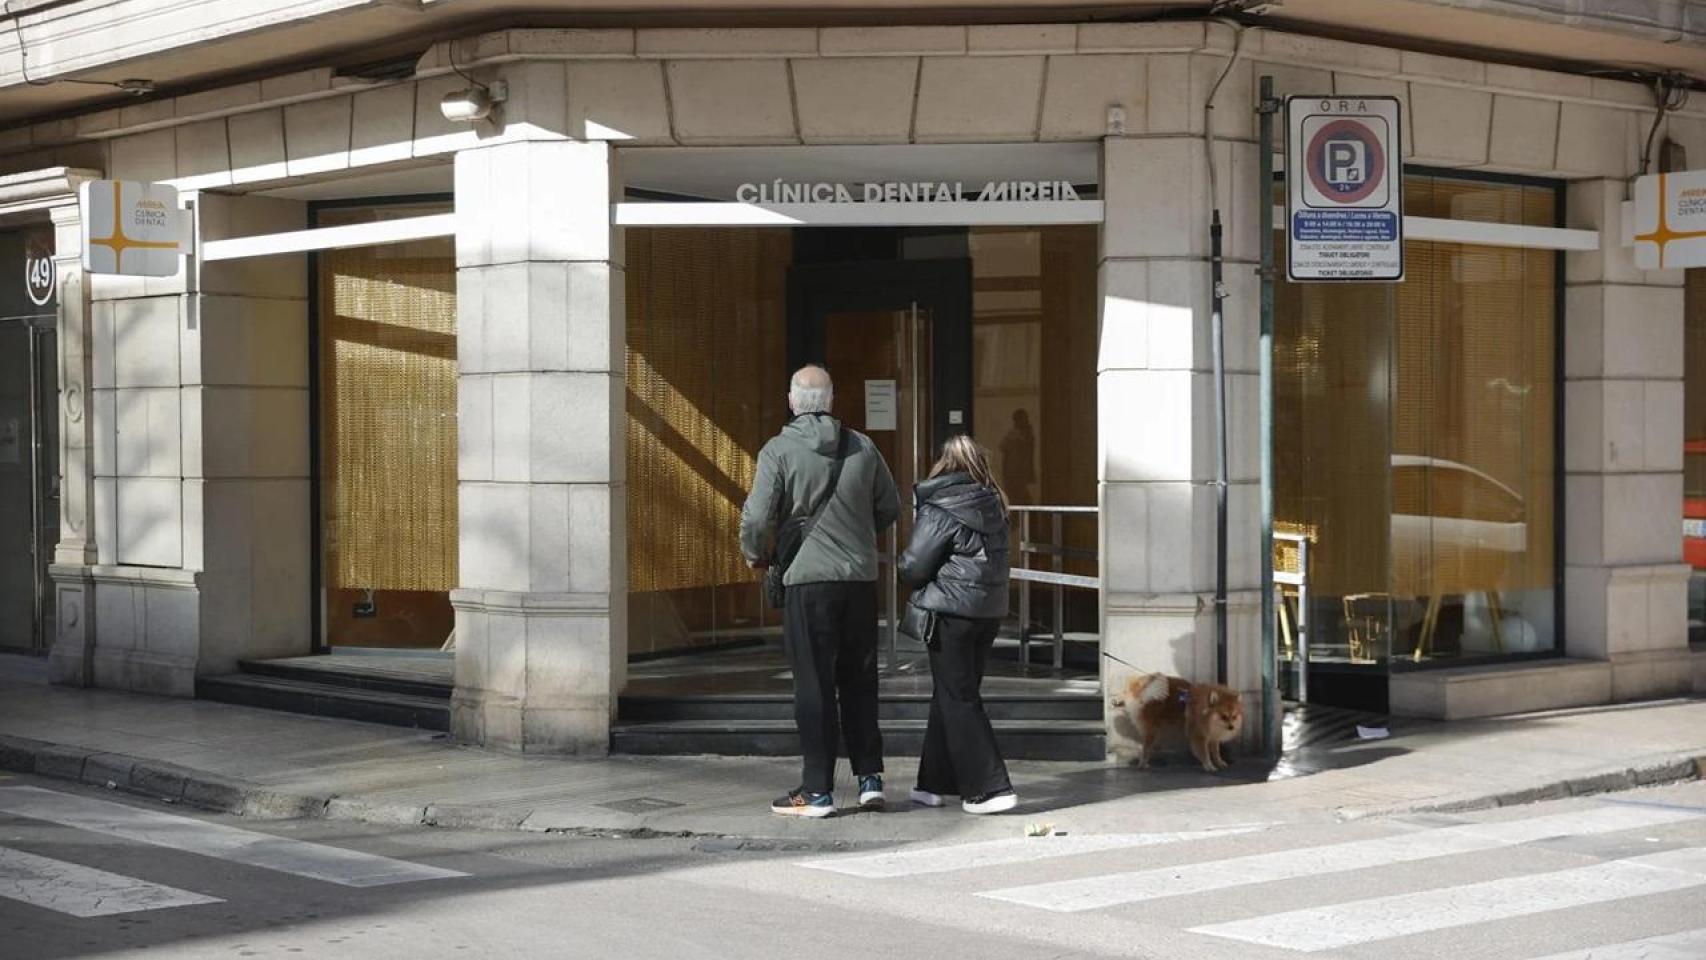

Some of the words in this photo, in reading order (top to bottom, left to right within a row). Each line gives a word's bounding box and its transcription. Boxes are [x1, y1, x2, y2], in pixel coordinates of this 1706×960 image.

[1321, 101, 1367, 112] ORA
[736, 177, 854, 203] CLÍNICA
[864, 182, 967, 203] DENTAL
[977, 181, 1081, 202] MIREIA
[31, 258, 50, 288] 49
